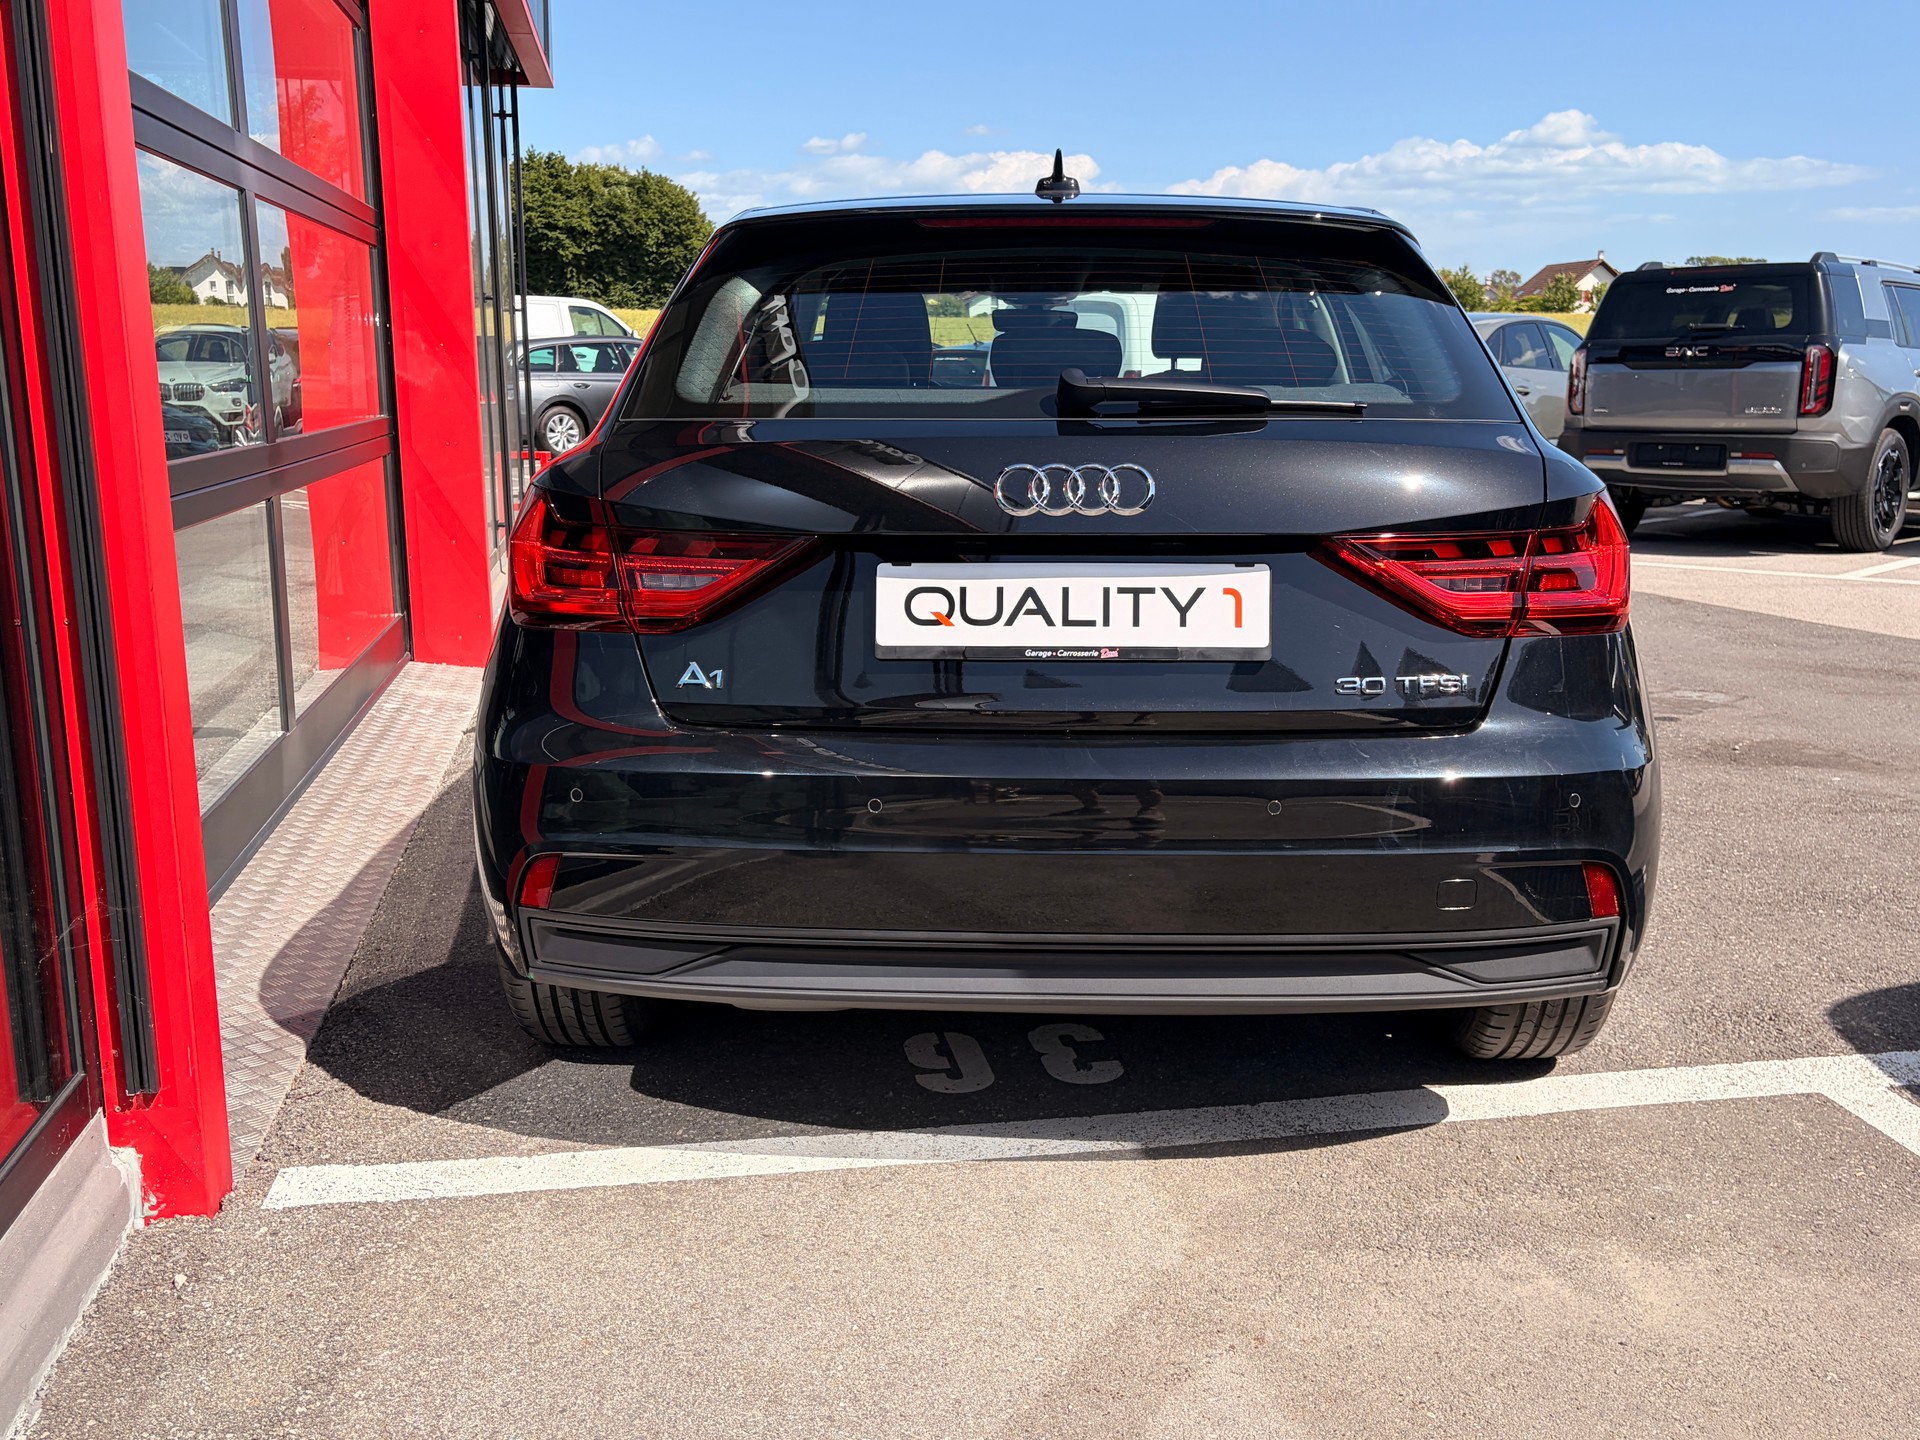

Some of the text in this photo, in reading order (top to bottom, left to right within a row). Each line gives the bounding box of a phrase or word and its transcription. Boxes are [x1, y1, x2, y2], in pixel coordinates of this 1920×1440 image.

[904, 586, 1206, 627] QUALITY
[1025, 649, 1052, 658] Garage
[1057, 649, 1099, 657] Carrosserie
[675, 661, 723, 689] A1
[1335, 674, 1470, 695] 30 TFSI
